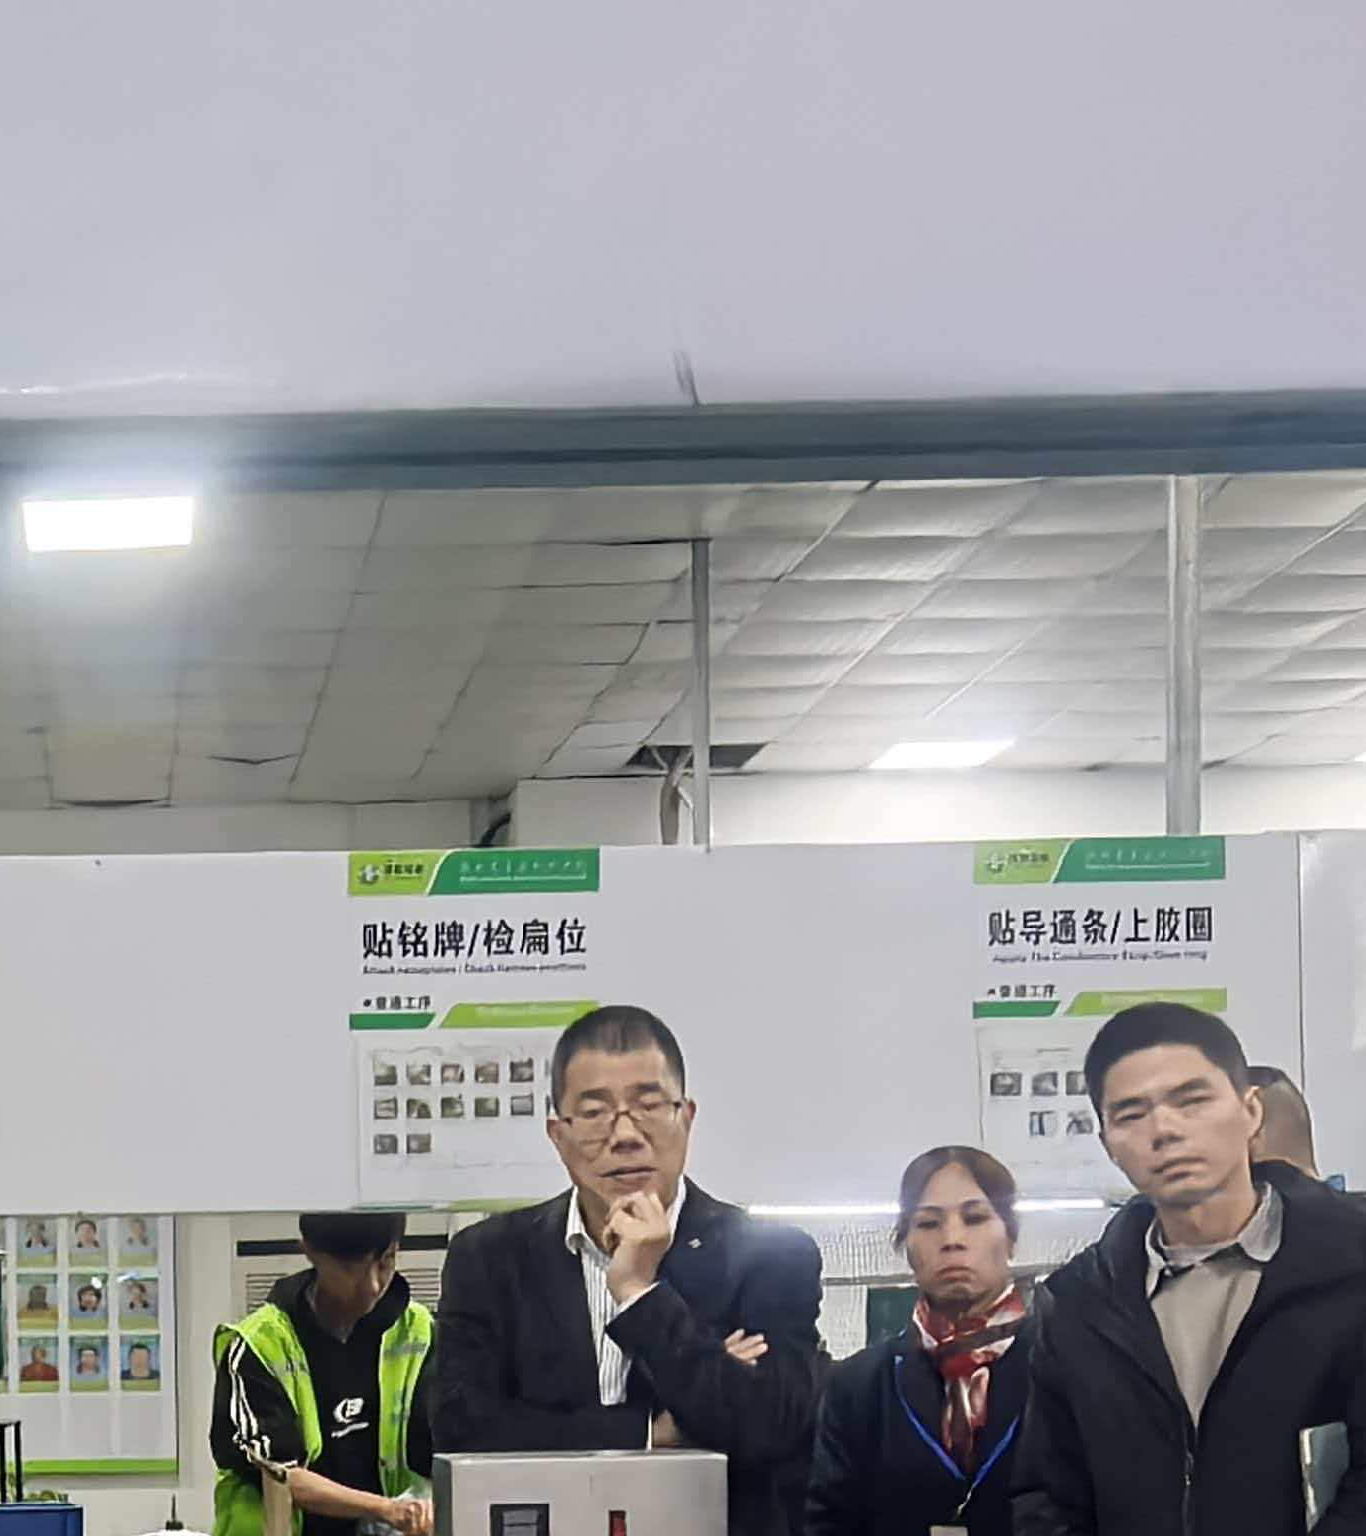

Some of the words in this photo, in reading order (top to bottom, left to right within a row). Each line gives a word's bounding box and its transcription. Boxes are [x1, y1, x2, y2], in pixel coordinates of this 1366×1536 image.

[362, 917, 588, 959] 贴铭牌/检扁位
[987, 905, 1213, 947] 贴导通条/上胶圈
